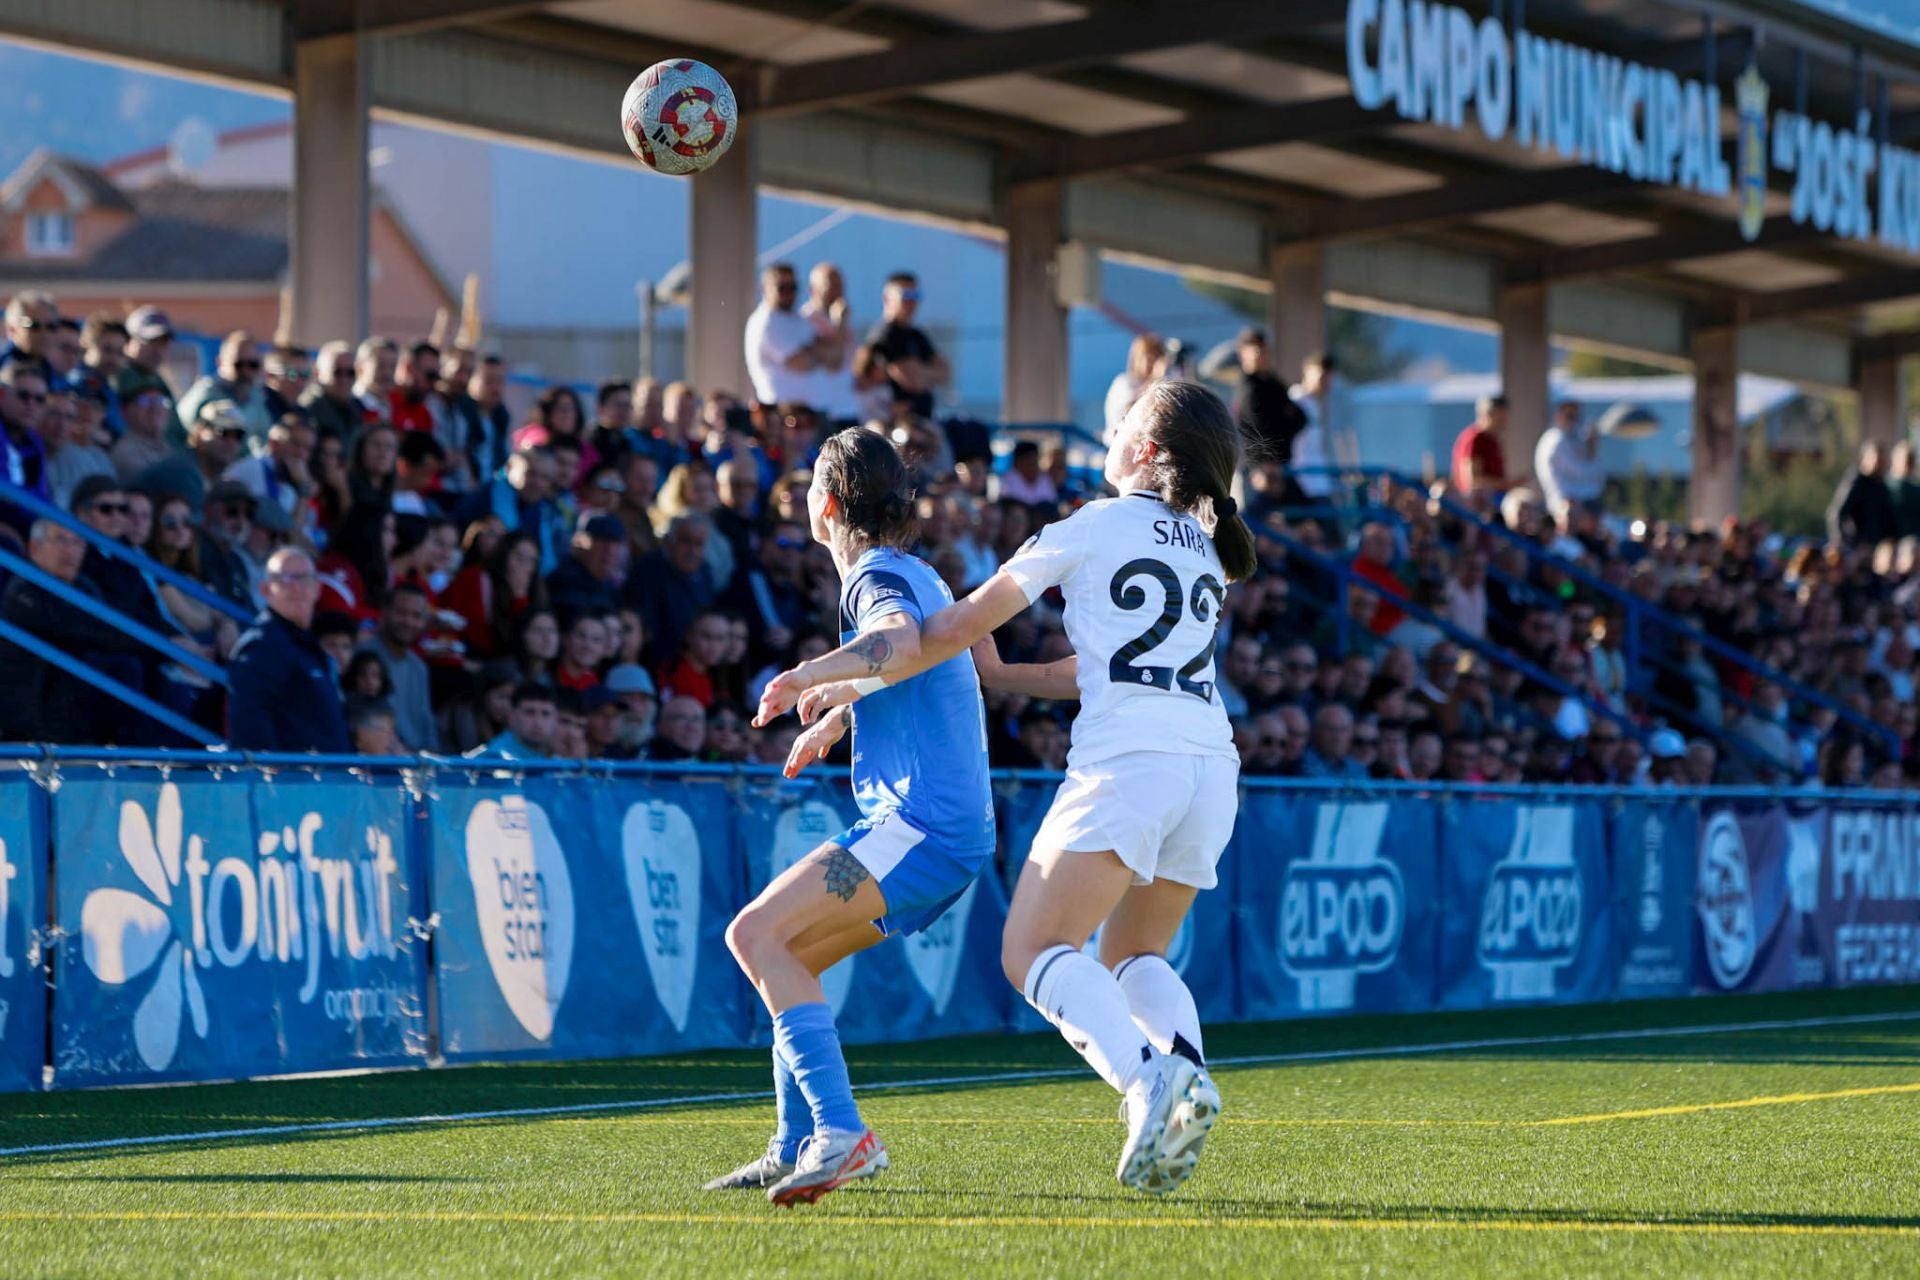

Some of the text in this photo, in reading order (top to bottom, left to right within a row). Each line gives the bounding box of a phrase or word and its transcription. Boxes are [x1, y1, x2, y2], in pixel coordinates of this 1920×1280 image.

[1346, 0, 1511, 142] CAMPO
[1514, 28, 1733, 196] MUNICIPAL
[1153, 520, 1206, 558] SARA
[1109, 558, 1224, 704] 22
